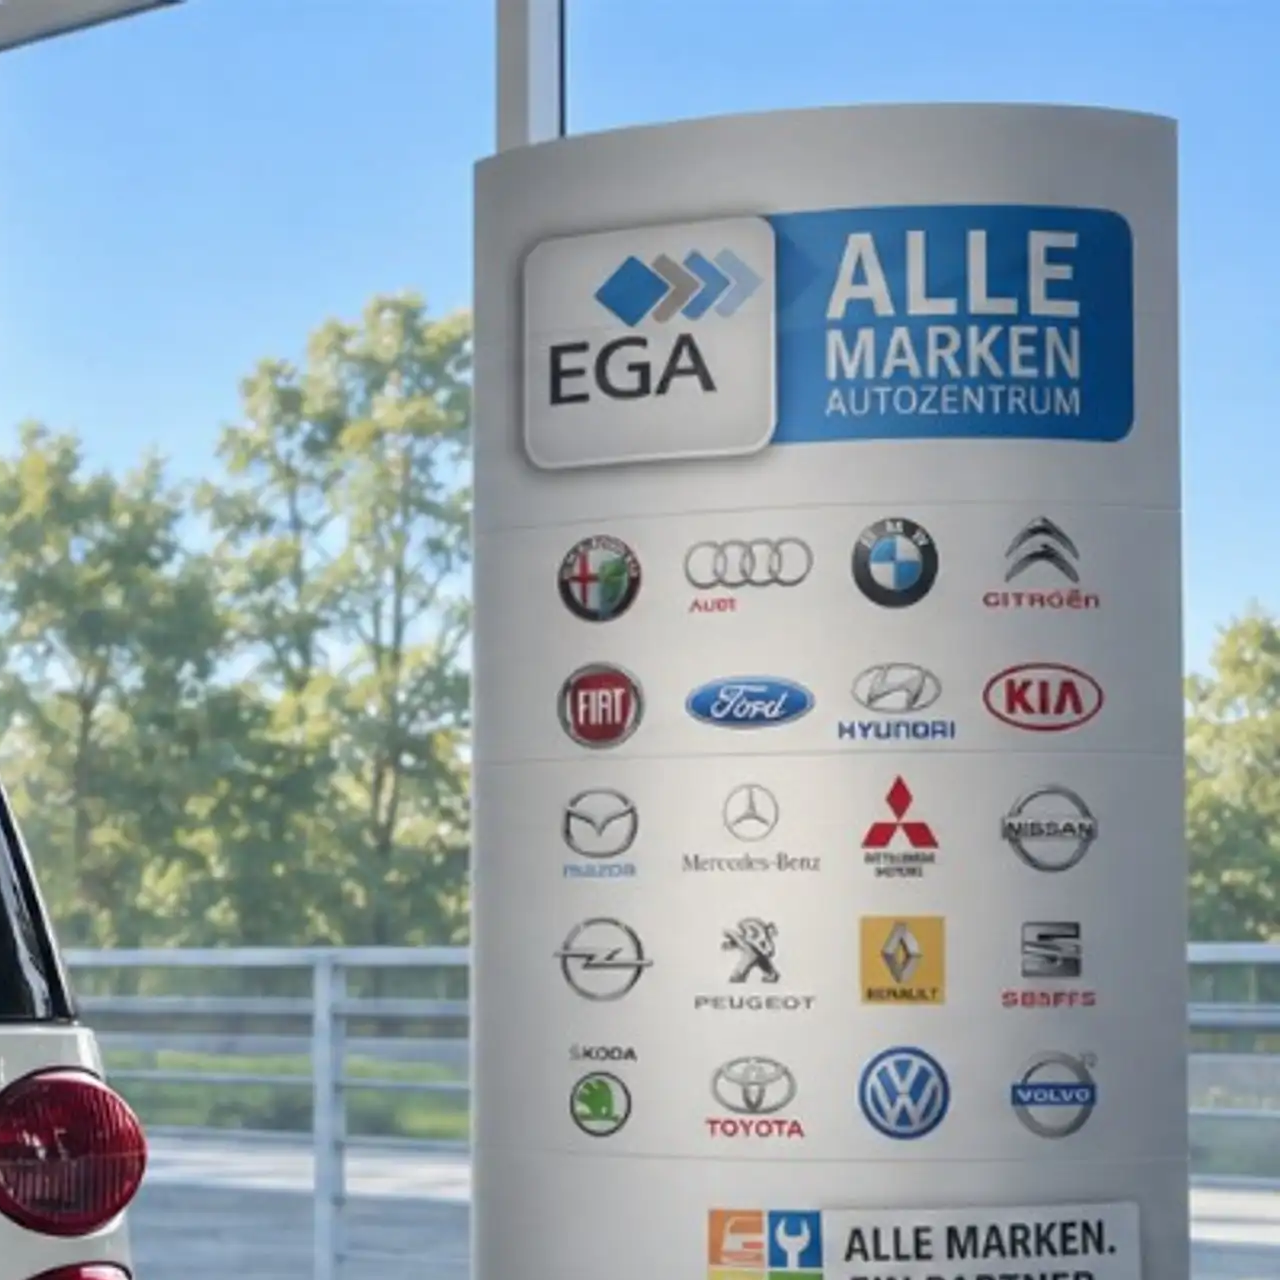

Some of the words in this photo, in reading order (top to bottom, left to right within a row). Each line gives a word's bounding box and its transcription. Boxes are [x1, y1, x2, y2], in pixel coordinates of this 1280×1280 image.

[826, 229, 1080, 320] ALLE
[548, 332, 717, 406] EGA
[825, 325, 1082, 382] MARKEN
[825, 385, 1082, 417] AUTOZENTRUM
[577, 688, 627, 728] FIAT
[708, 685, 787, 720] Ford
[1004, 678, 1085, 716] KIA
[681, 853, 822, 872] Mercedes-Benz
[693, 995, 816, 1010] PEUGEOT
[1016, 1088, 1091, 1103] VOLVO
[706, 1118, 805, 1138] TOYOTA
[844, 1226, 934, 1263] ALLE
[946, 1219, 1118, 1261] MARKEN.
